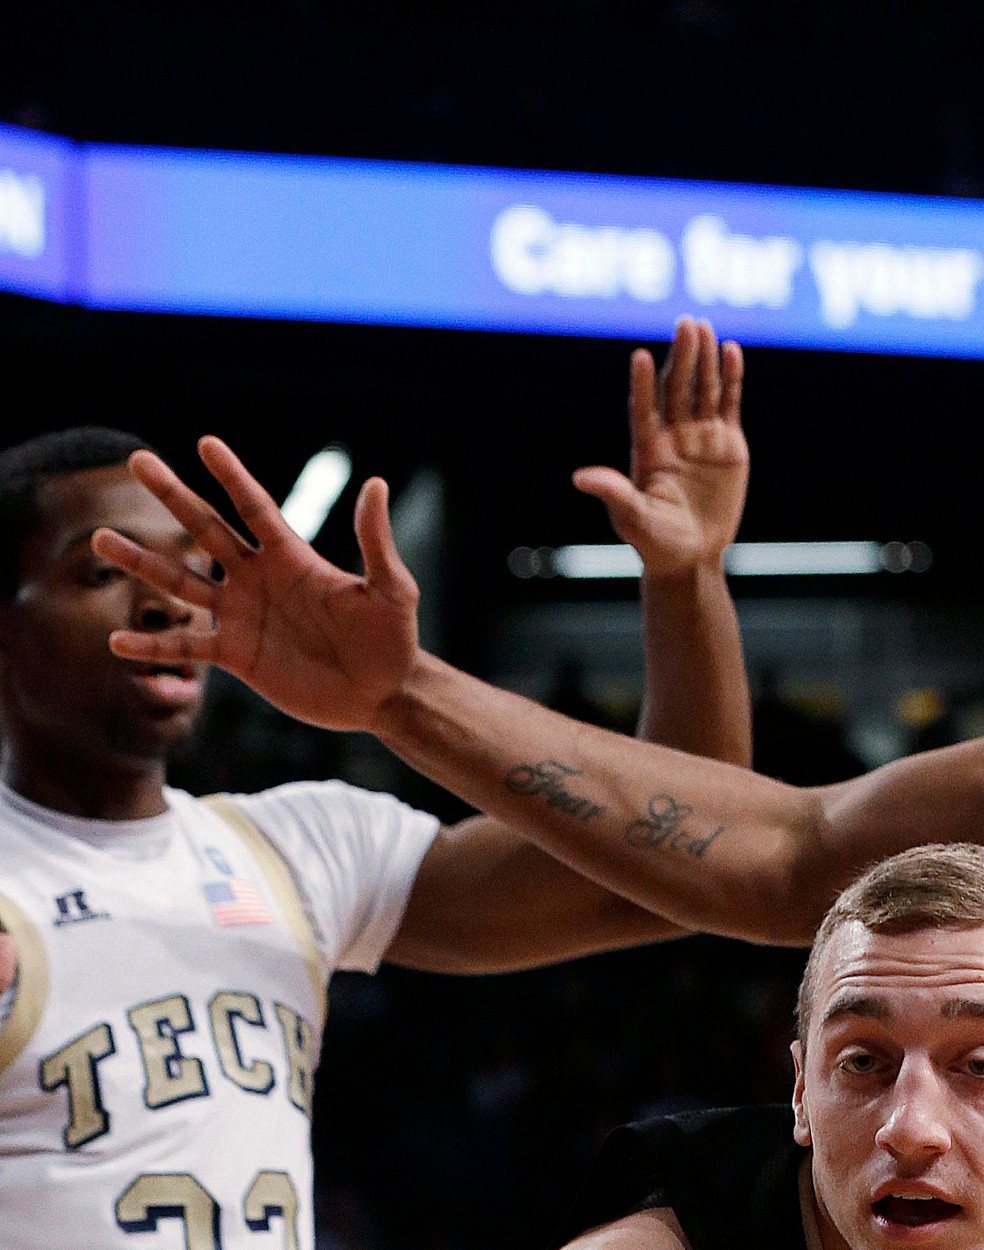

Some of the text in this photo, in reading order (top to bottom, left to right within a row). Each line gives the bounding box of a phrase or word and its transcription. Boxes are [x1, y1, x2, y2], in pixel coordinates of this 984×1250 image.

[490, 203, 675, 303] Care
[682, 213, 801, 310] for
[38, 990, 317, 1150] TECH
